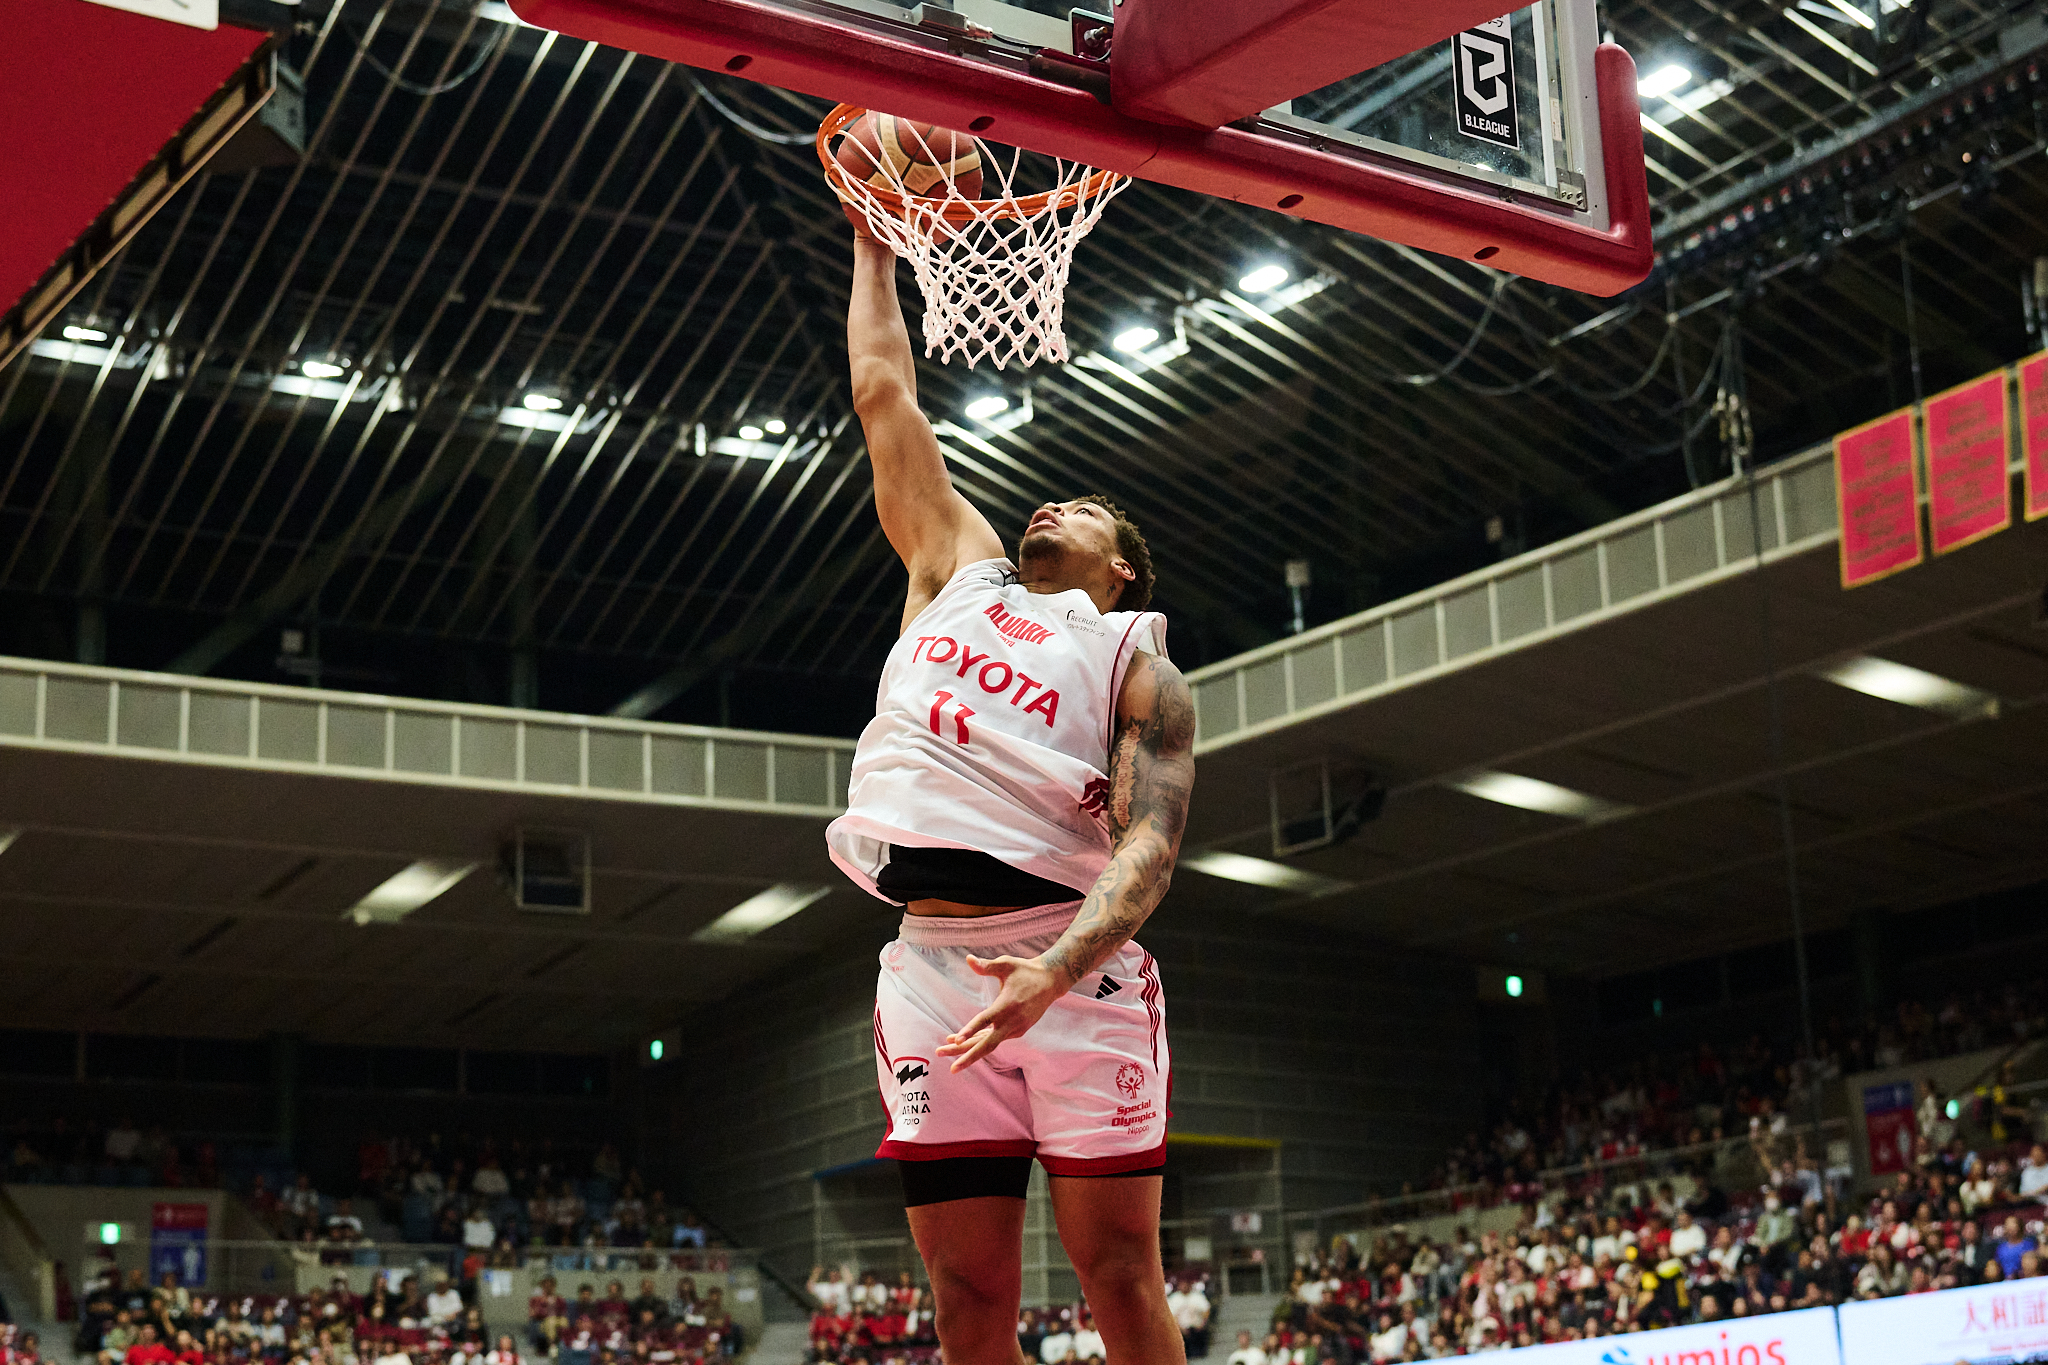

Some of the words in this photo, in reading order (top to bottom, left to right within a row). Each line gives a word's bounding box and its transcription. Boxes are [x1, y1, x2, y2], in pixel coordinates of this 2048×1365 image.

[1464, 113, 1510, 138] B.LEAGUE
[983, 602, 1056, 645] ALVARK
[1071, 615, 1098, 627] RECRUIT
[912, 636, 1060, 729] TOYOTA
[929, 690, 976, 745] 11
[901, 1091, 930, 1101] YOTA
[1117, 1099, 1151, 1115] Special
[1111, 1111, 1156, 1127] Olympics
[1127, 1125, 1150, 1135] Nippon
